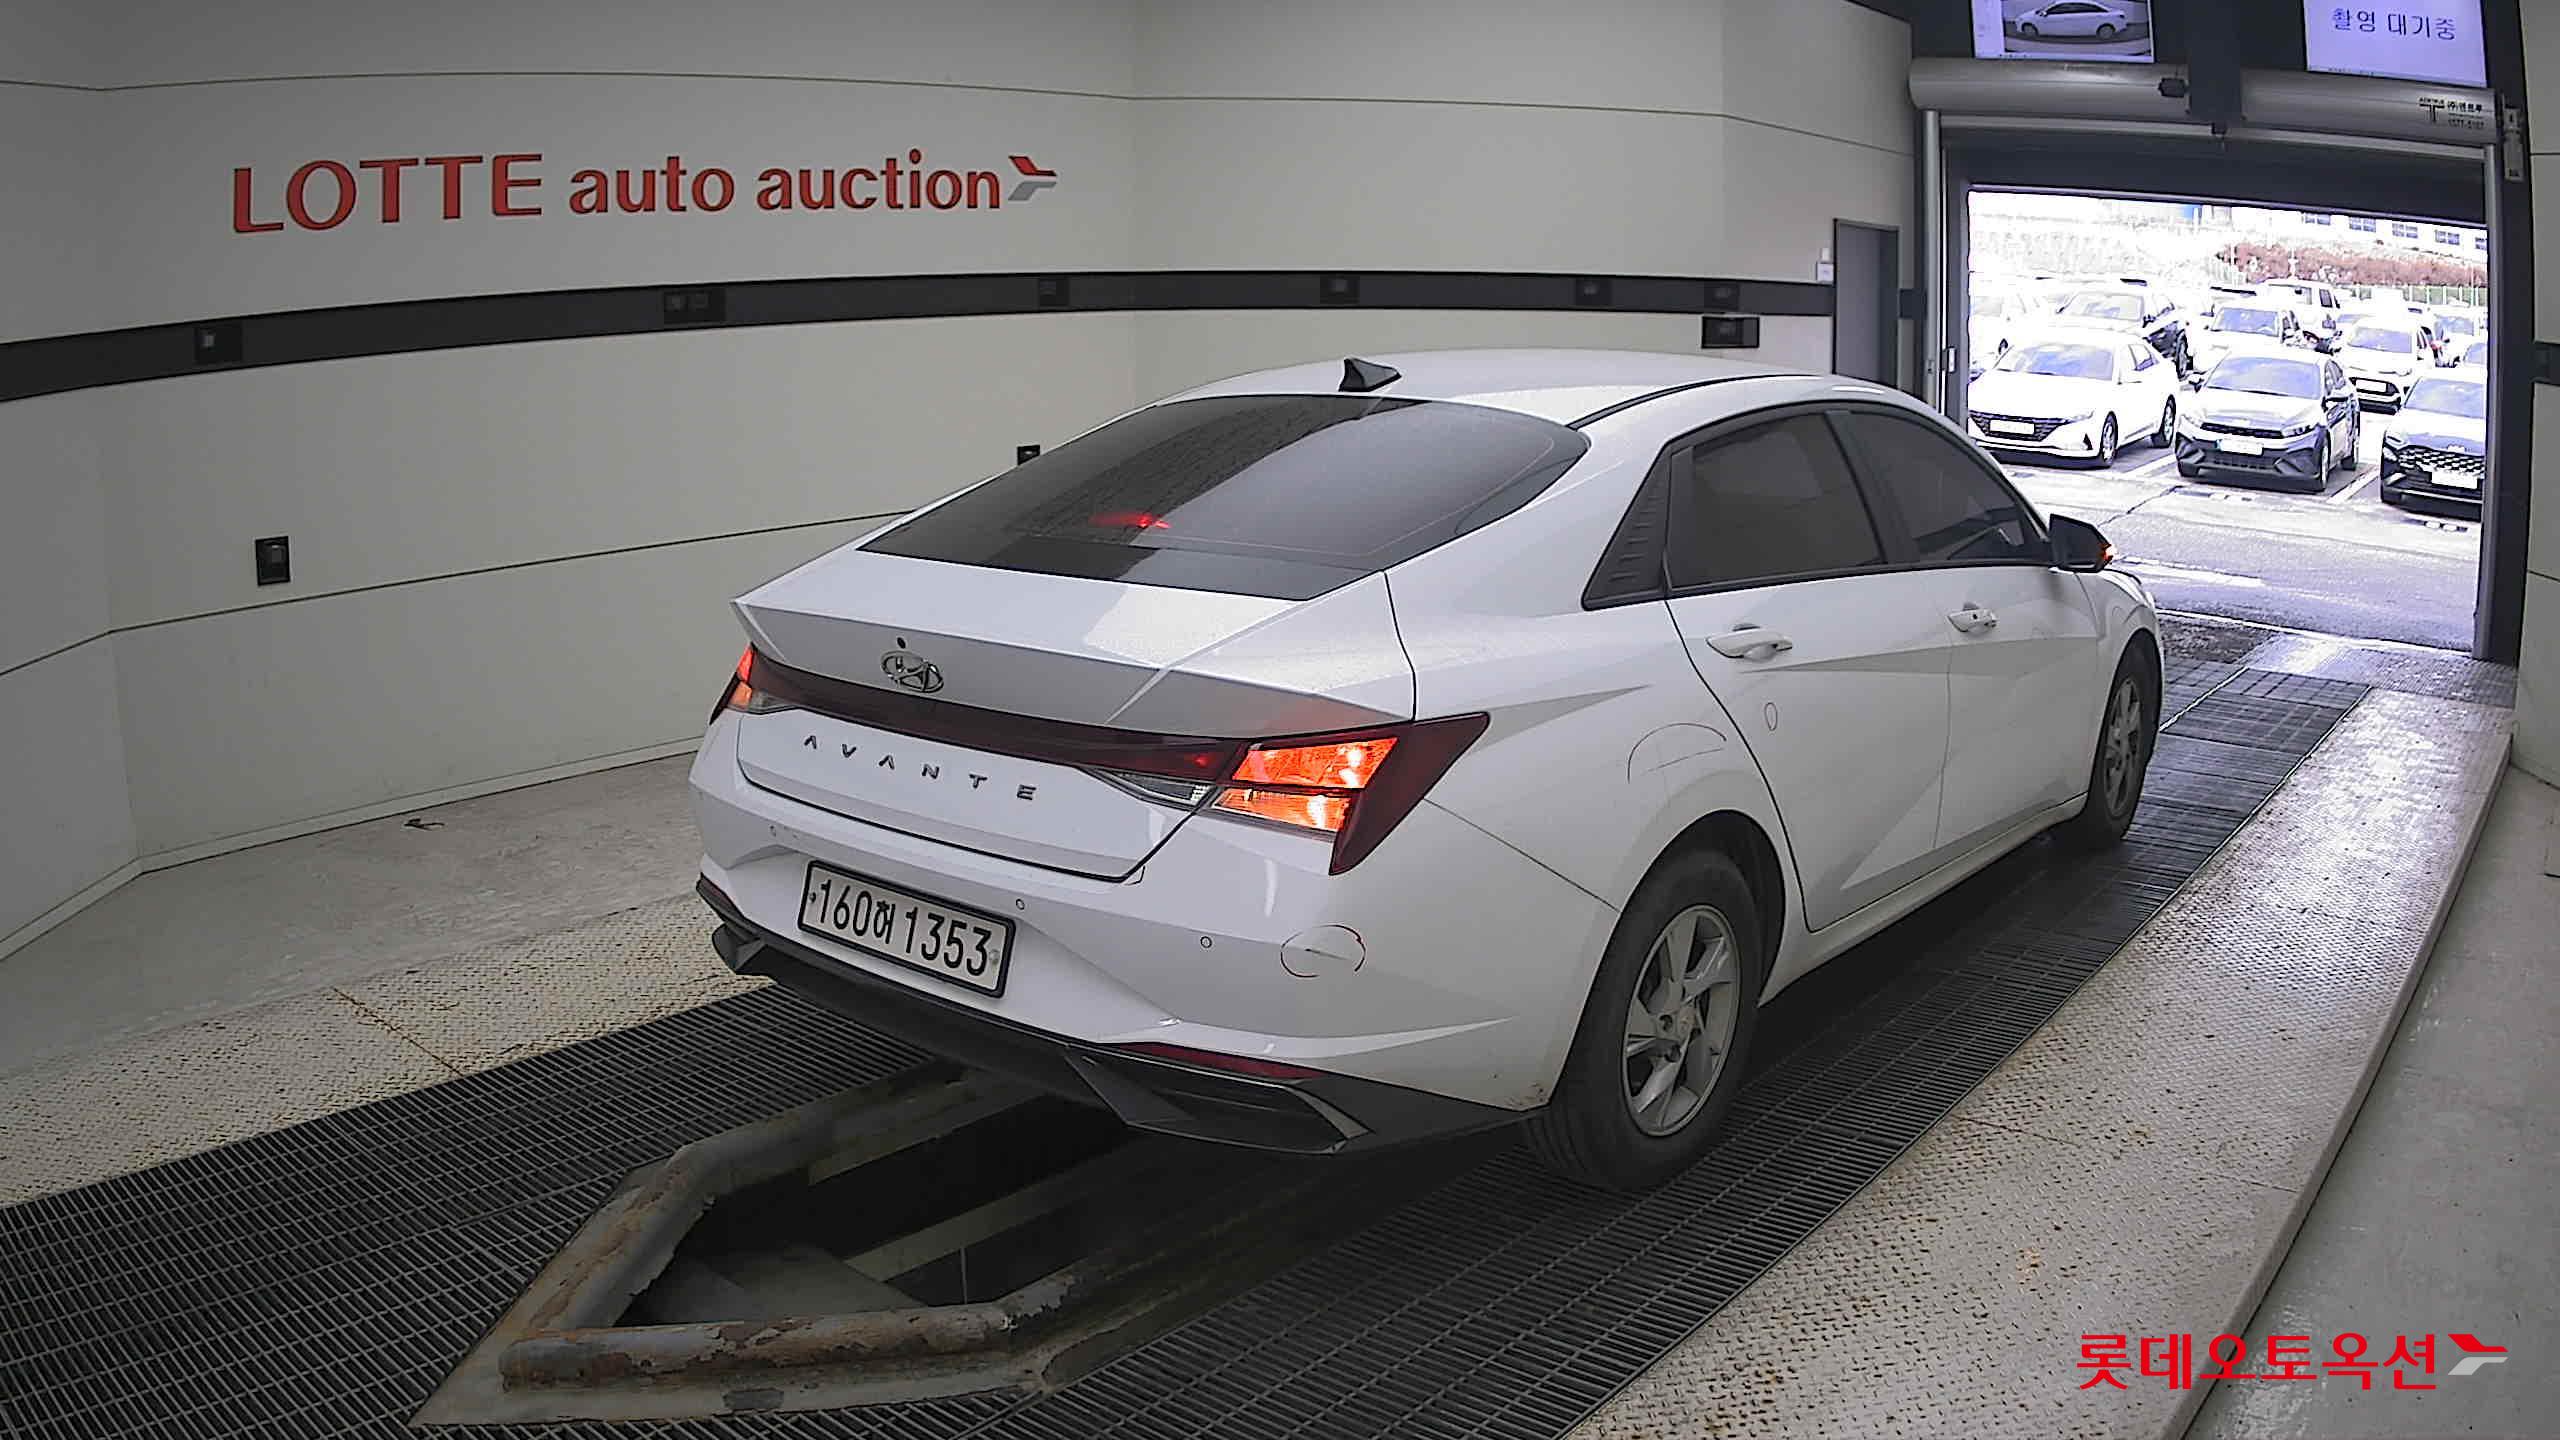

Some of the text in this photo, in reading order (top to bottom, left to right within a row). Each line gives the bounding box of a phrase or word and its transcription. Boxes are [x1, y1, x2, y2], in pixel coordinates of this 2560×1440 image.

[2333, 8, 2456, 41] 촬영 대기중
[233, 148, 1002, 233] LOTTE auto auction
[803, 735, 1037, 801] AVANTE
